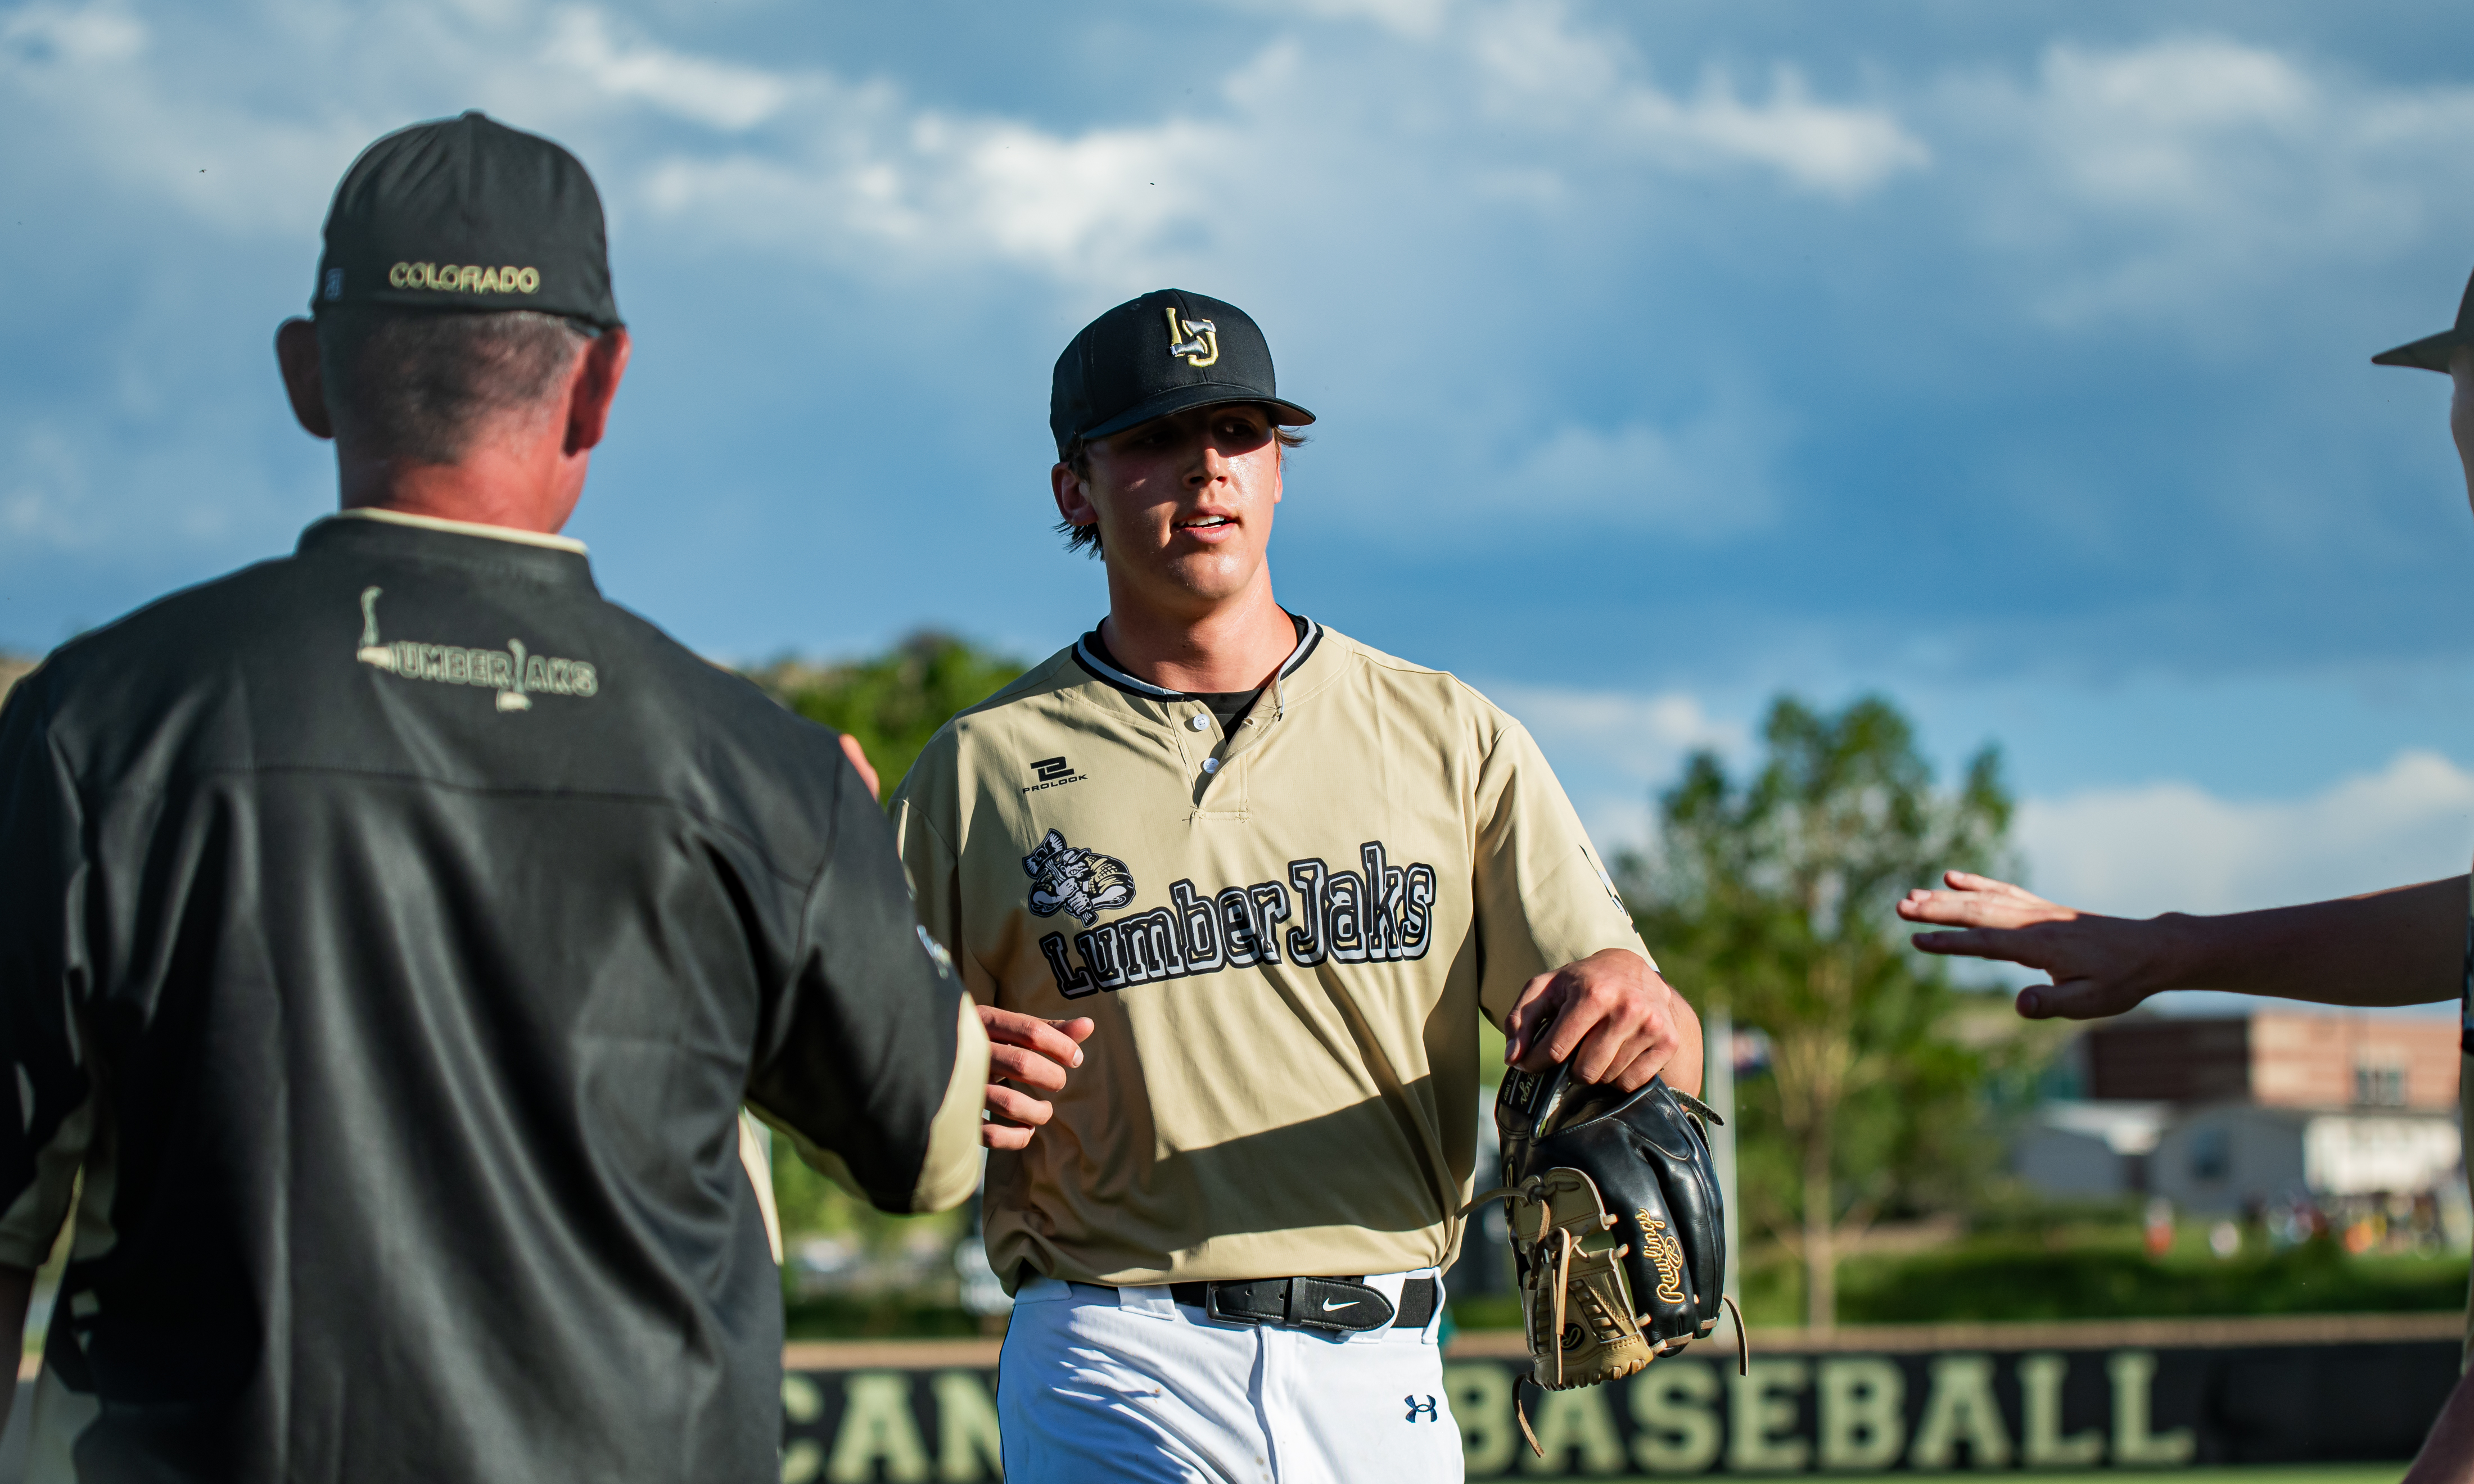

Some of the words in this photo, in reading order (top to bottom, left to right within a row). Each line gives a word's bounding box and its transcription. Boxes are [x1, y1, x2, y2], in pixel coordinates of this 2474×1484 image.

[390, 262, 540, 294] COLORADO
[1022, 773, 1088, 794] PROLOOK
[1039, 840, 1437, 1001] LumberJaks
[1635, 1208, 1685, 1304] Rawlings
[1443, 1352, 2196, 1472] BASEBALL
